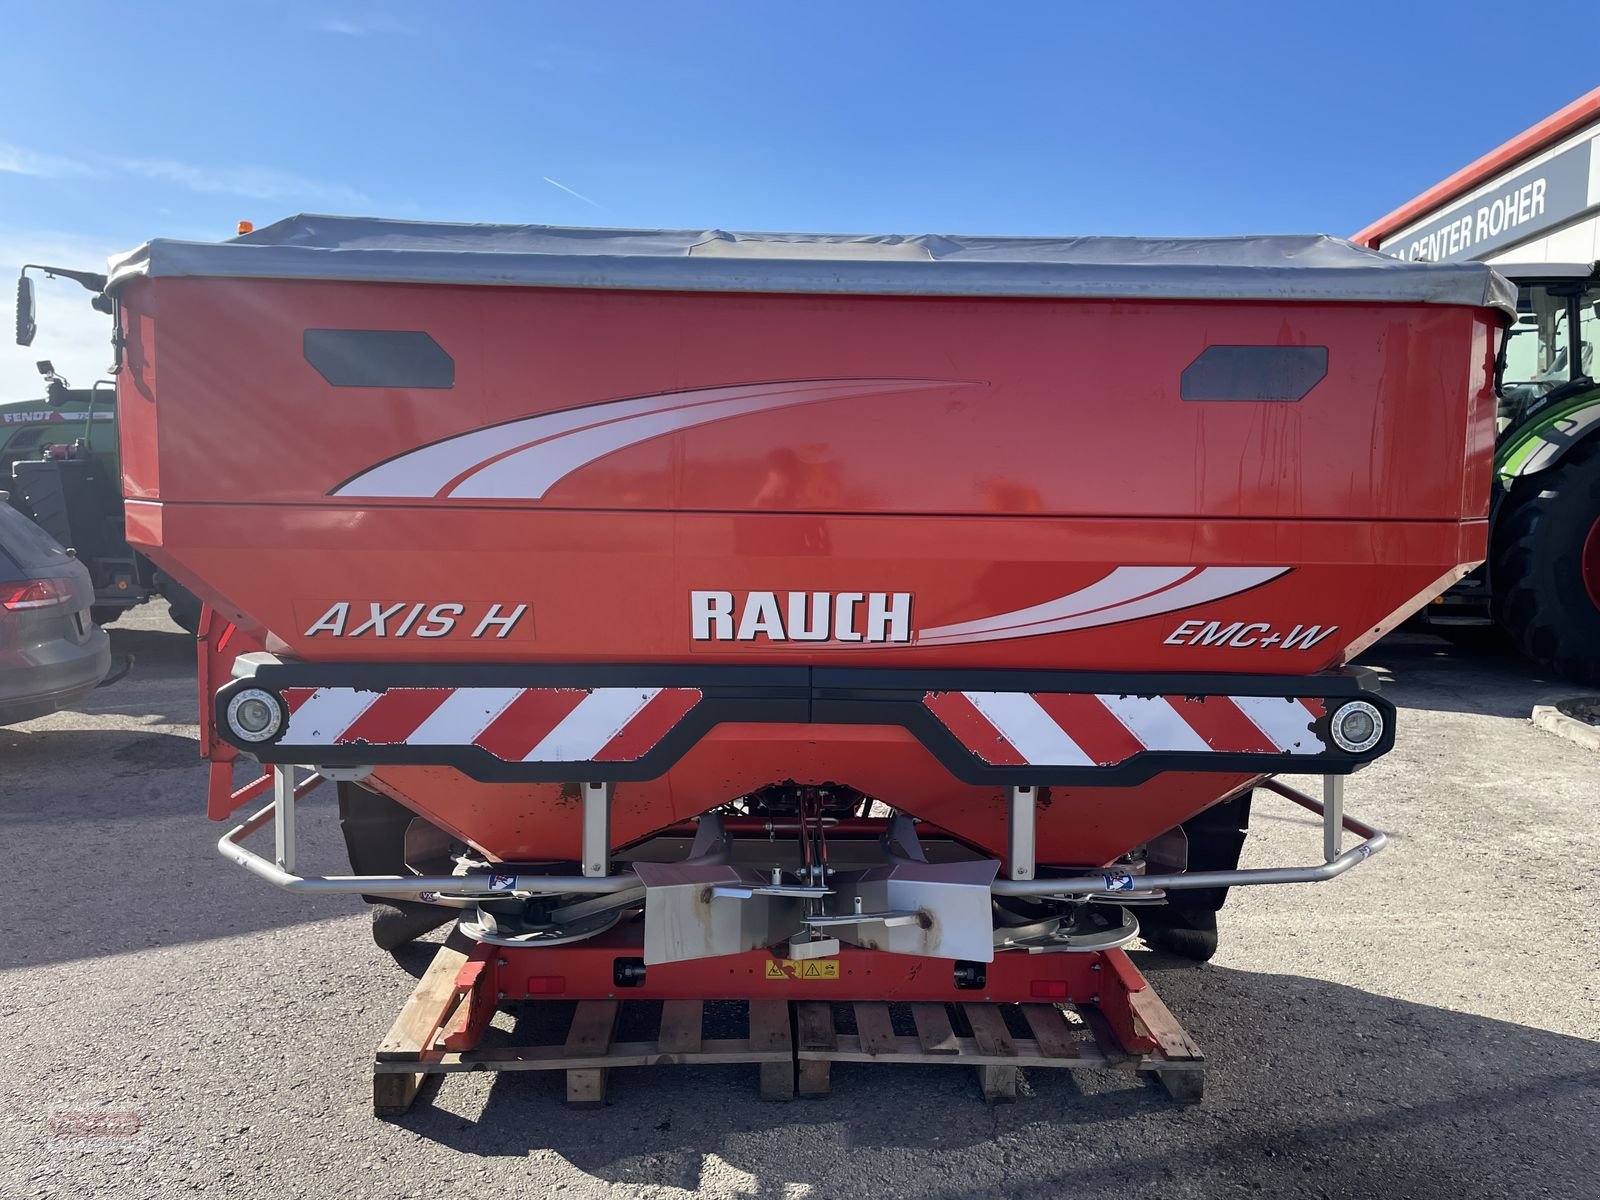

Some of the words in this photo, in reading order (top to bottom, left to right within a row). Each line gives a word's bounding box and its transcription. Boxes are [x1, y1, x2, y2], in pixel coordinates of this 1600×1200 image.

[1408, 214, 1473, 262] CENTER
[1475, 178, 1546, 243] ROHER
[3, 411, 54, 422] FENDT
[304, 602, 464, 638] AXIS
[471, 604, 528, 638] H
[691, 591, 912, 643] RAUCH
[1163, 620, 1339, 650] EMC+W
